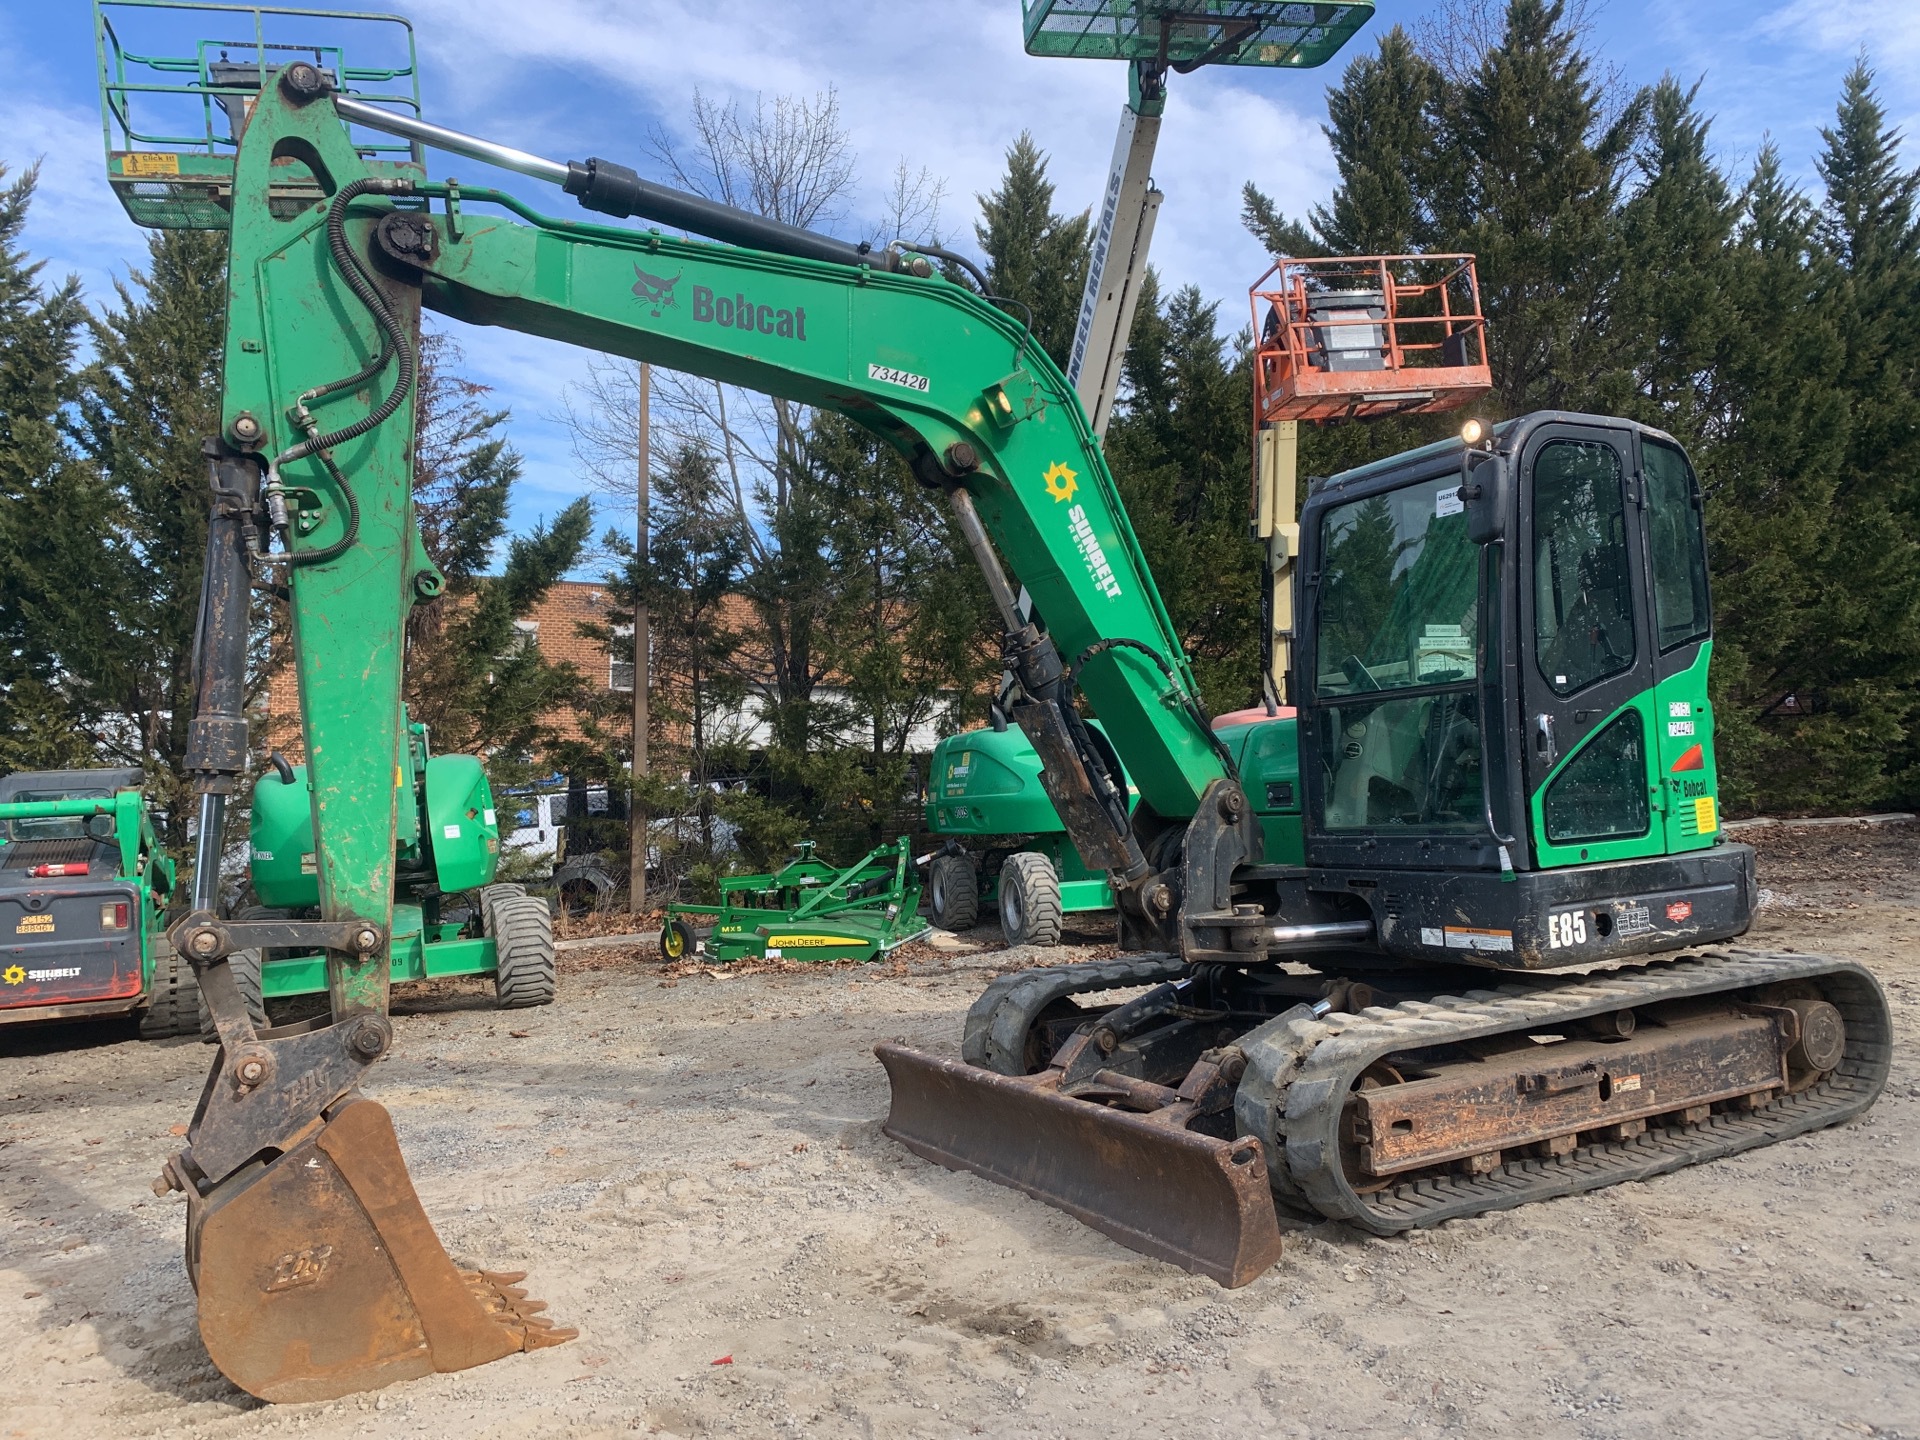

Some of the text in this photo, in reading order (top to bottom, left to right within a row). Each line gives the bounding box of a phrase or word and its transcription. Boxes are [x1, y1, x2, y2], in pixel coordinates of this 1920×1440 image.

[1088, 172, 1121, 298] RENTALS
[693, 284, 807, 342] Bobcat
[871, 364, 928, 390] 734420
[1068, 504, 1122, 598] SUNBELT
[1068, 524, 1103, 591] RENTALS
[1669, 722, 1693, 735] 734420
[1683, 778, 1707, 797] Bobcat
[21, 914, 52, 924] PC152
[1548, 910, 1587, 949] E85
[773, 938, 826, 948] JOHN DEERE
[28, 967, 81, 979] SUNBELT
